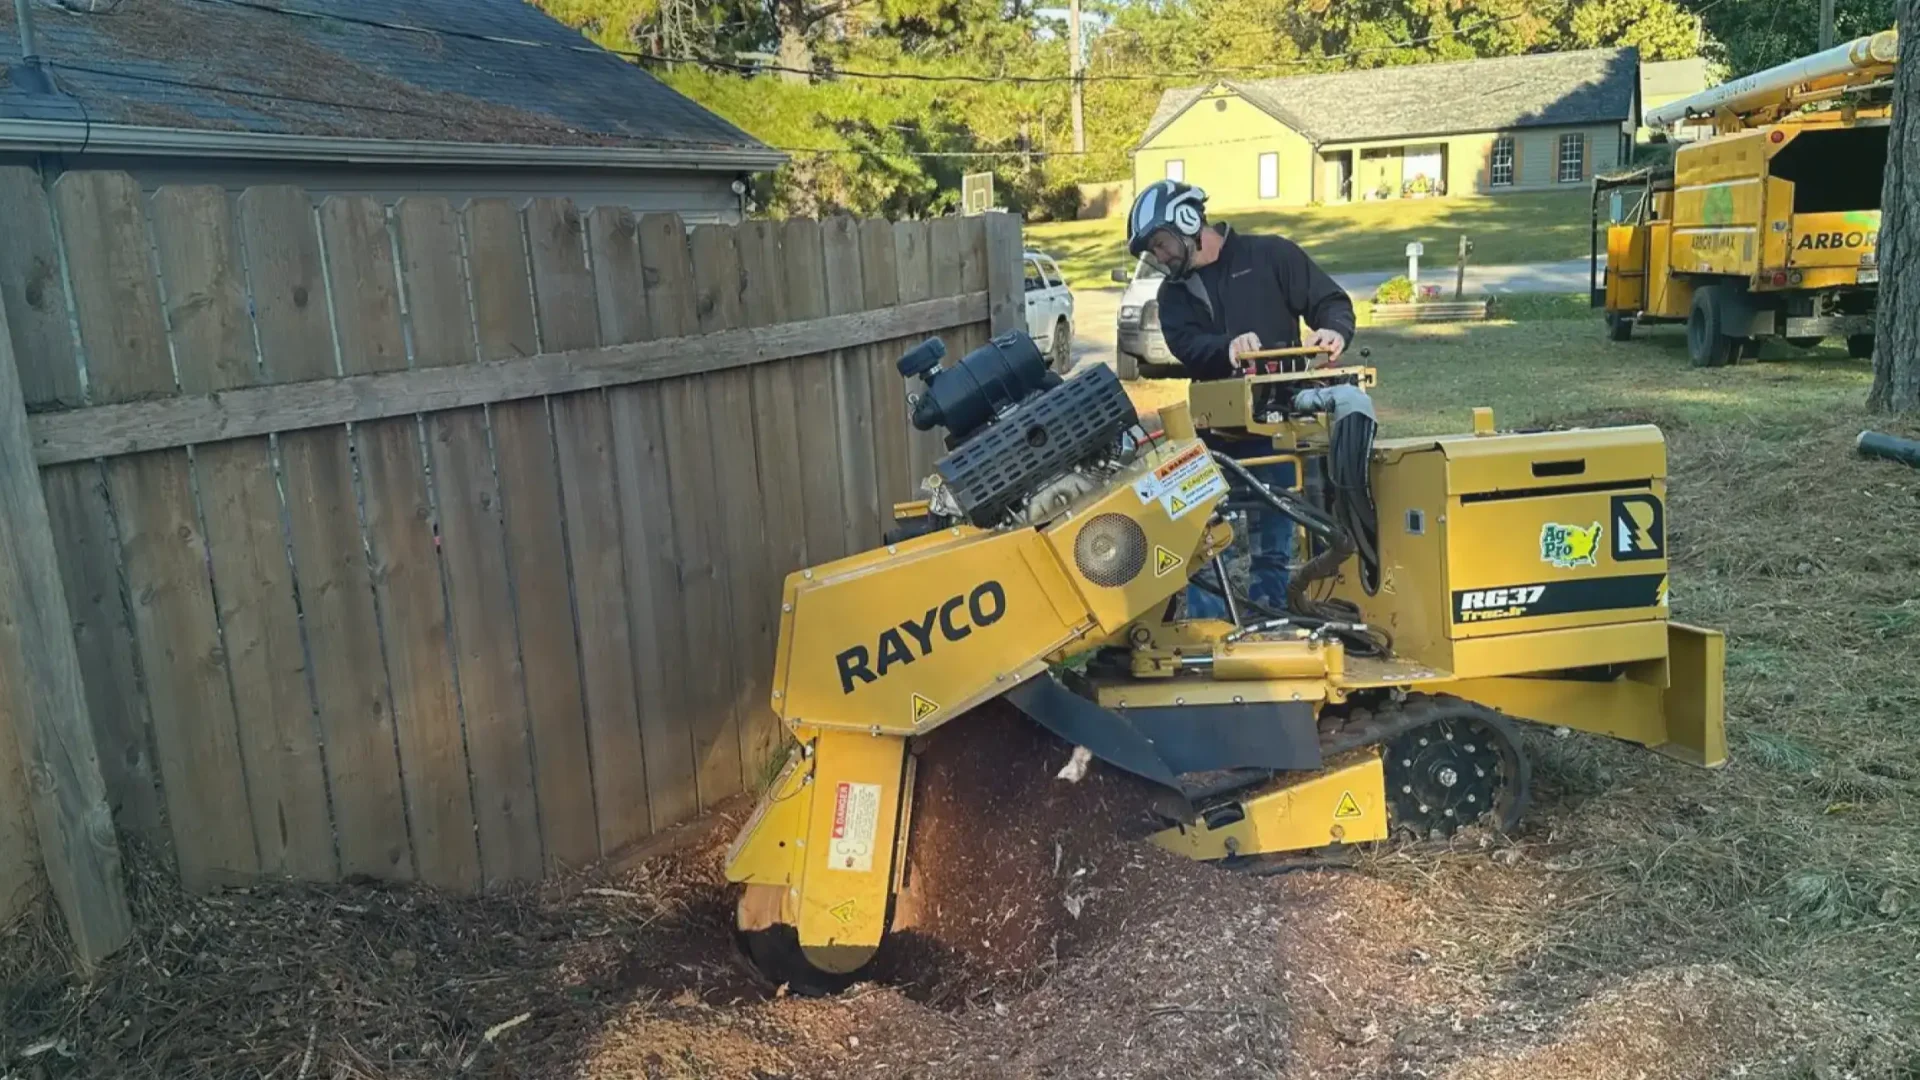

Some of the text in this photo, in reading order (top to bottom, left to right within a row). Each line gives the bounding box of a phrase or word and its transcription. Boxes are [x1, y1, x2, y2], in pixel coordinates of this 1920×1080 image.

[1544, 542, 1573, 559] Pro
[1461, 585, 1546, 610] RG37
[836, 580, 1006, 695] RAYCO
